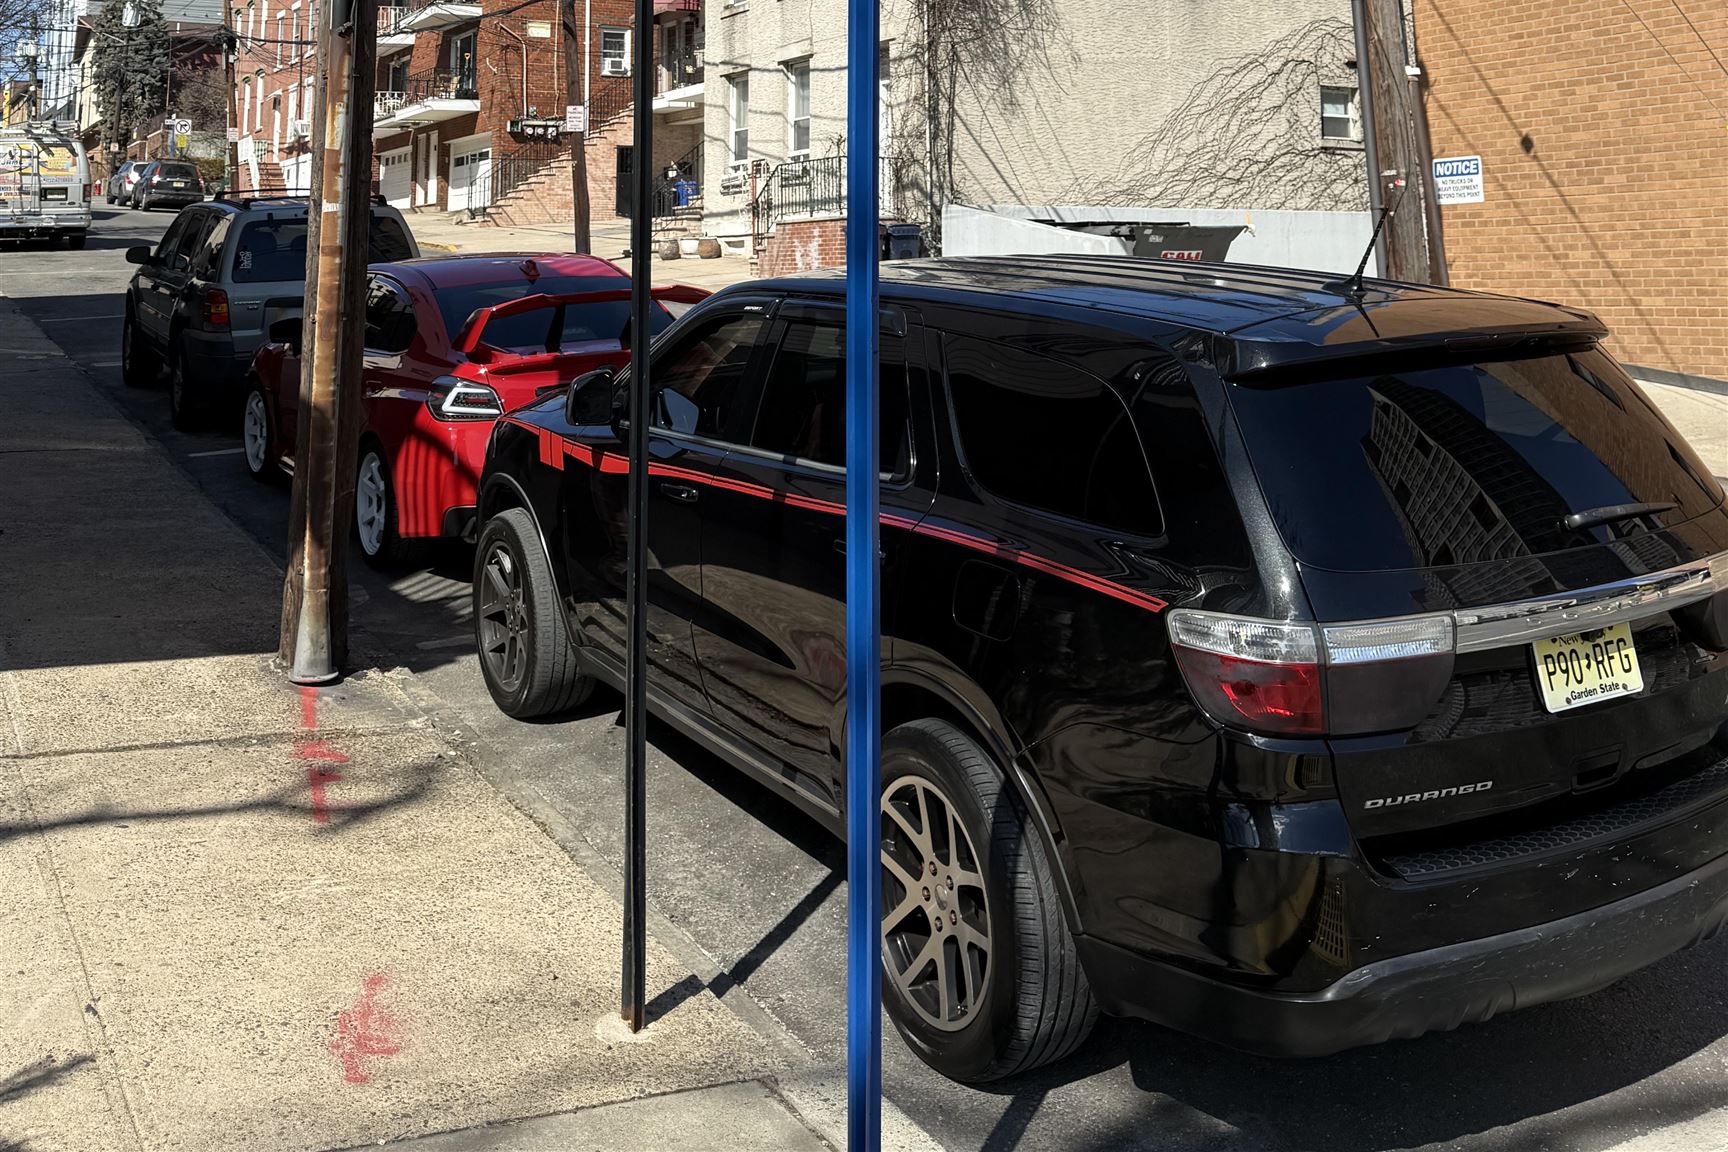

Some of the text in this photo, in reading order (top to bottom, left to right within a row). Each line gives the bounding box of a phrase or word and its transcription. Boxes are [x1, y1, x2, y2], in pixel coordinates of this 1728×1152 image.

[1436, 161, 1478, 176] NOTICE
[1570, 681, 1620, 702] Garden State
[1364, 780, 1493, 809] DURANGO
